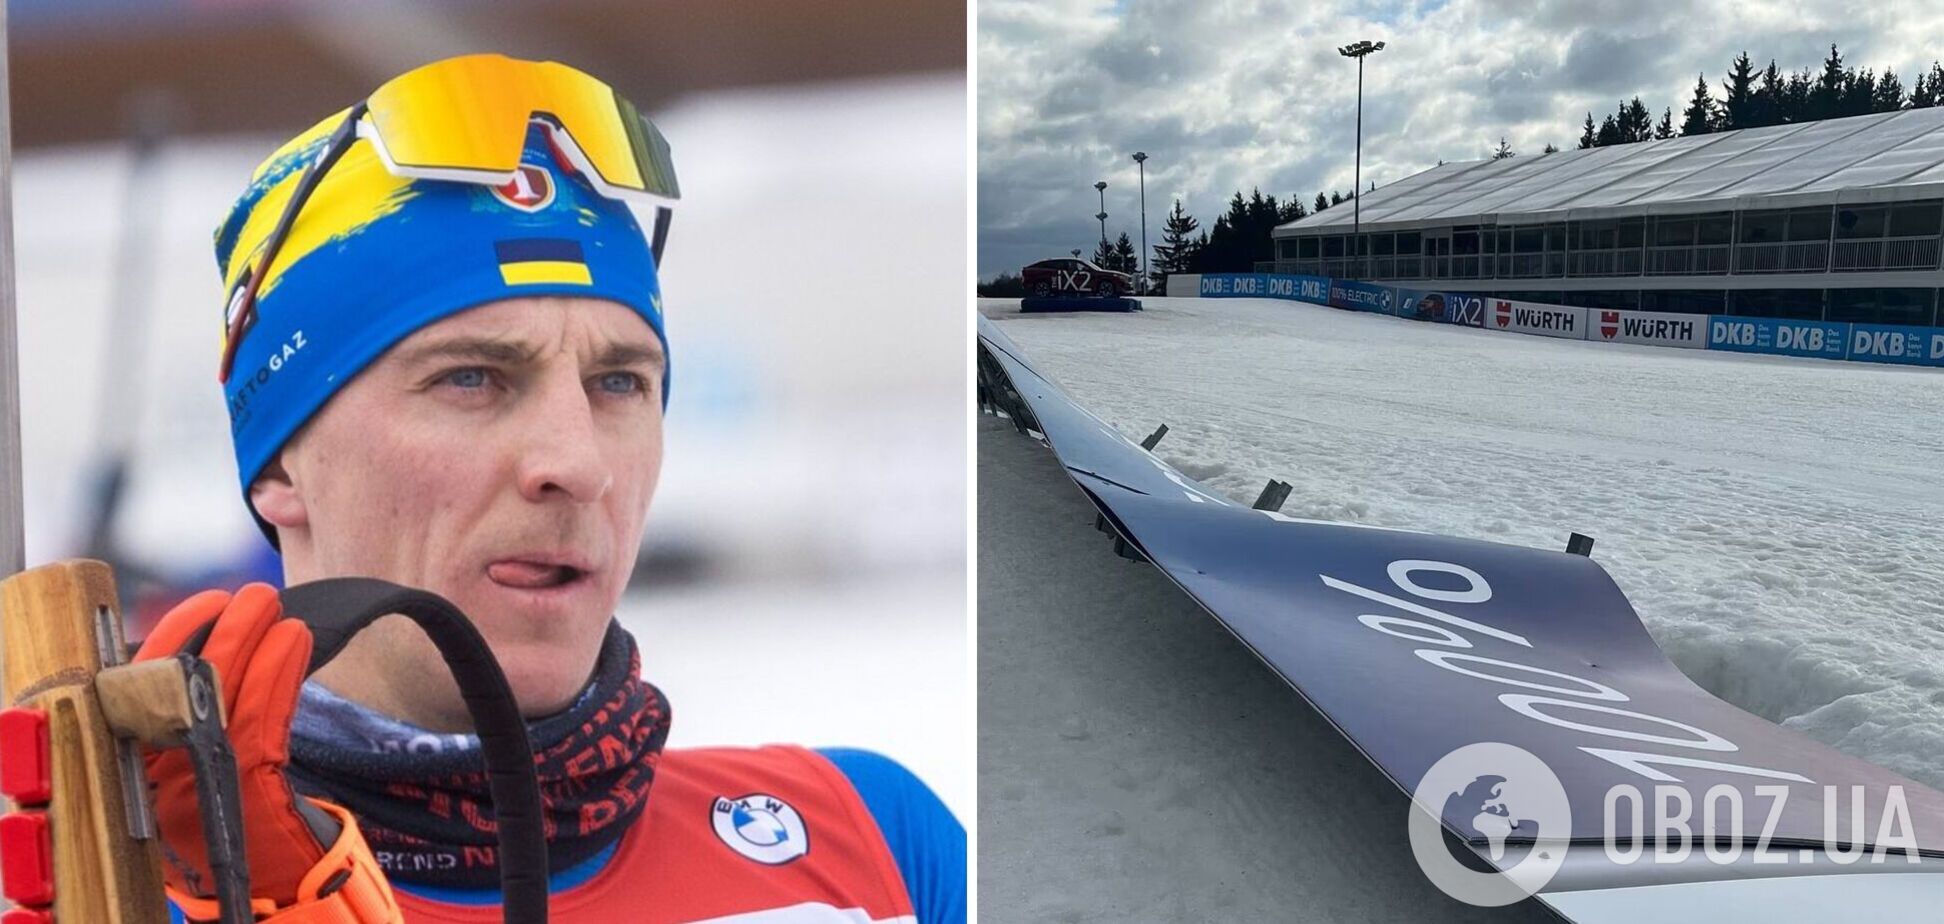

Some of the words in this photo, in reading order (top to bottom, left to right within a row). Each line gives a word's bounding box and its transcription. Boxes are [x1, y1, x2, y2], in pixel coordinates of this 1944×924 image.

[1057, 270, 1092, 292] iX2
[1201, 277, 1223, 293] DKB
[1233, 277, 1256, 293] DKB
[1269, 278, 1293, 296] DKB
[1300, 280, 1320, 299] DKB
[1331, 287, 1347, 301] 100%
[1347, 288, 1379, 306] ELECTRIC
[1452, 296, 1482, 325] iX2
[1711, 321, 1756, 346] DKB
[1776, 325, 1824, 351] DKB
[1853, 330, 1905, 357] DKB
[231, 329, 308, 421] AFTOGAZ
[1319, 558, 1816, 784] 100%
